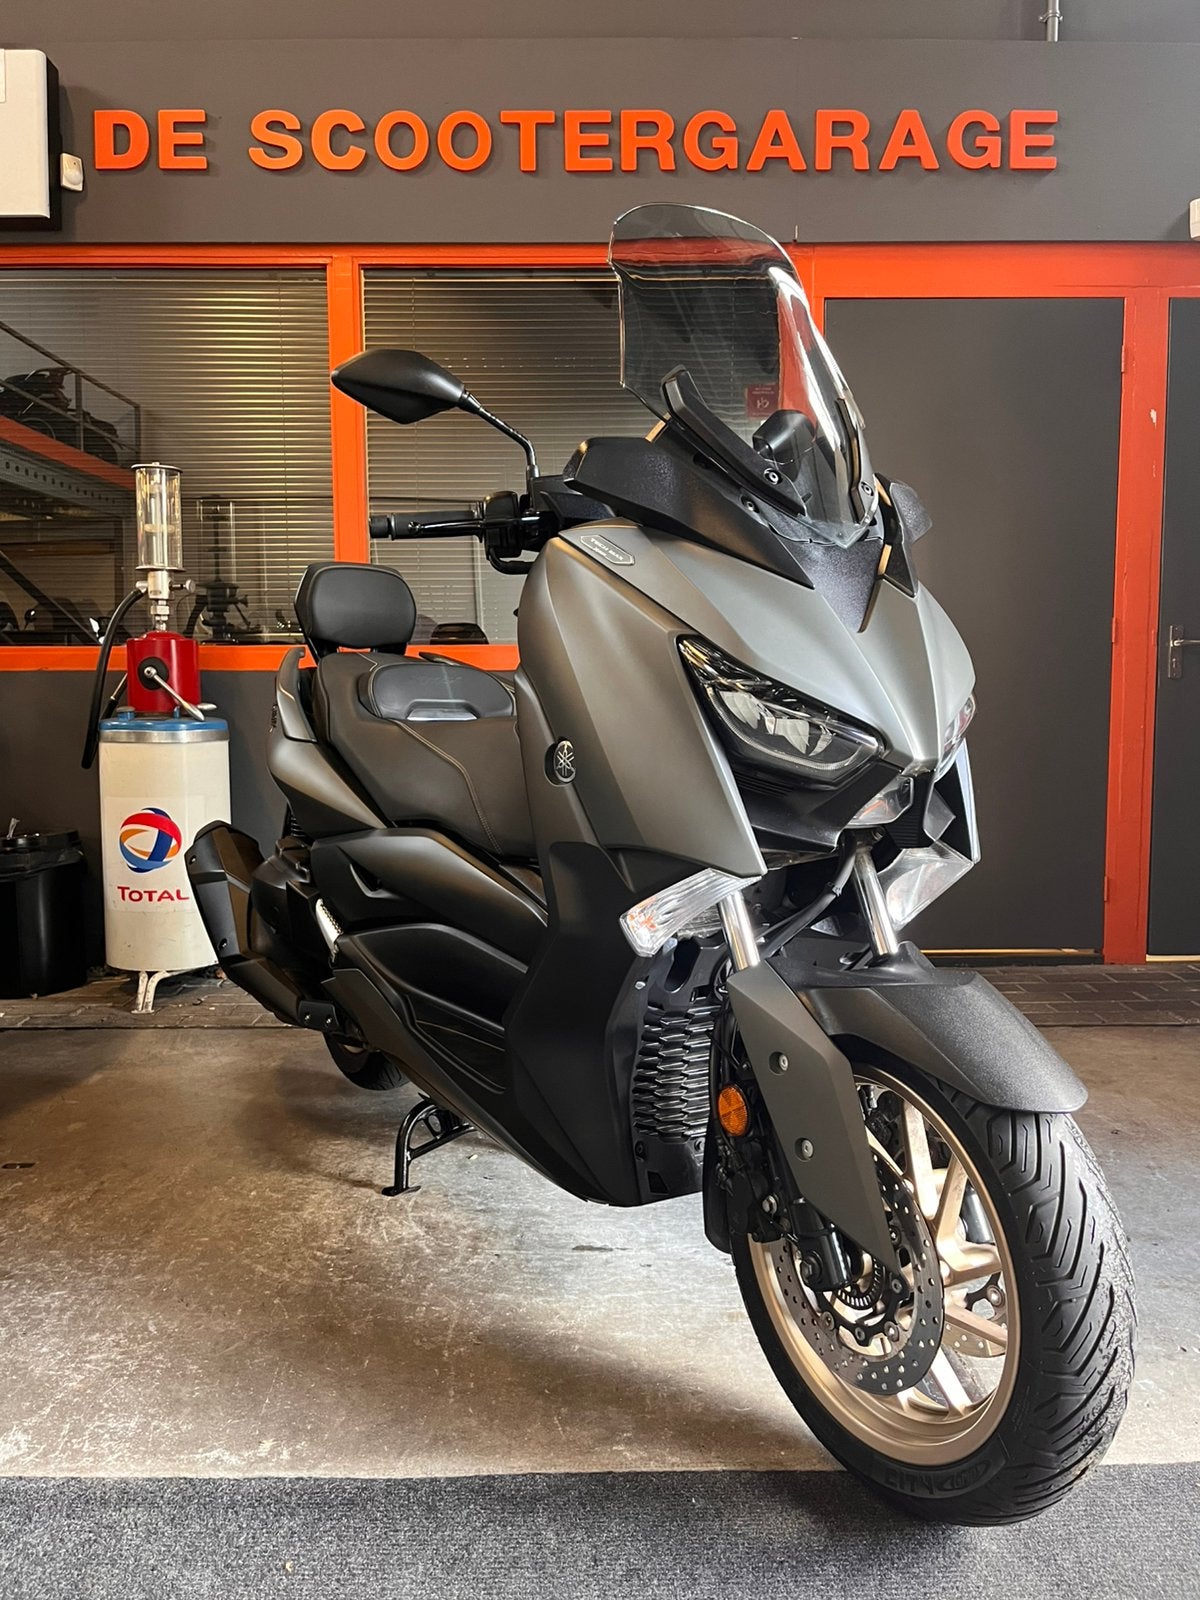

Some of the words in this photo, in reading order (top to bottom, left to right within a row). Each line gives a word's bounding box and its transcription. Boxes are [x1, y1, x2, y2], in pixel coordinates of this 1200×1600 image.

[94, 109, 208, 170] DE
[249, 109, 1059, 171] SCOOTERGARAGE
[117, 886, 190, 902] TOTAL
